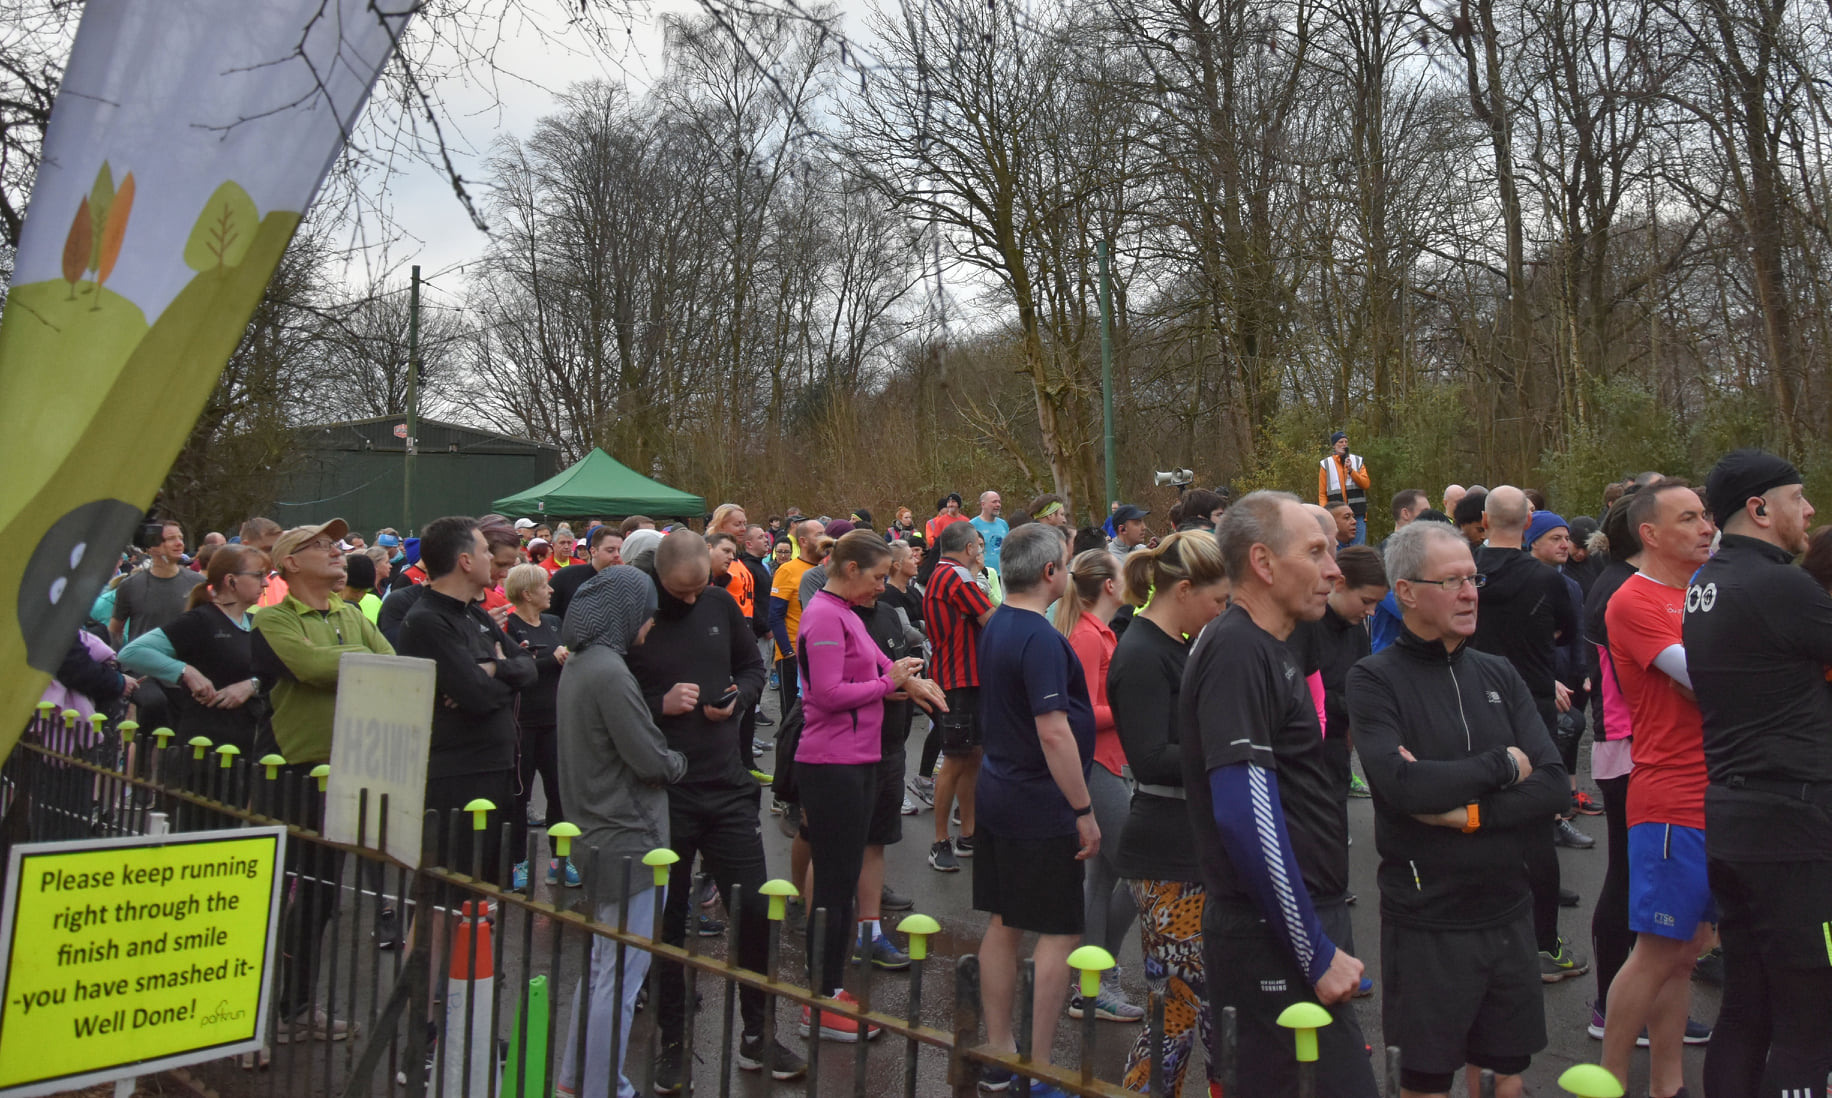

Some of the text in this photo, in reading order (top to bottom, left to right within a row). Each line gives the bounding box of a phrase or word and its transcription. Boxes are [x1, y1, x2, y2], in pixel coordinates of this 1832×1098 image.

[40, 856, 259, 892] Please keep running
[53, 891, 240, 932] right through the
[57, 926, 228, 967] finish and smile
[13, 987, 67, 1015] -you
[73, 979, 129, 1002] have
[135, 959, 228, 993] smashed
[73, 998, 246, 1038] Well Done! parkrun
